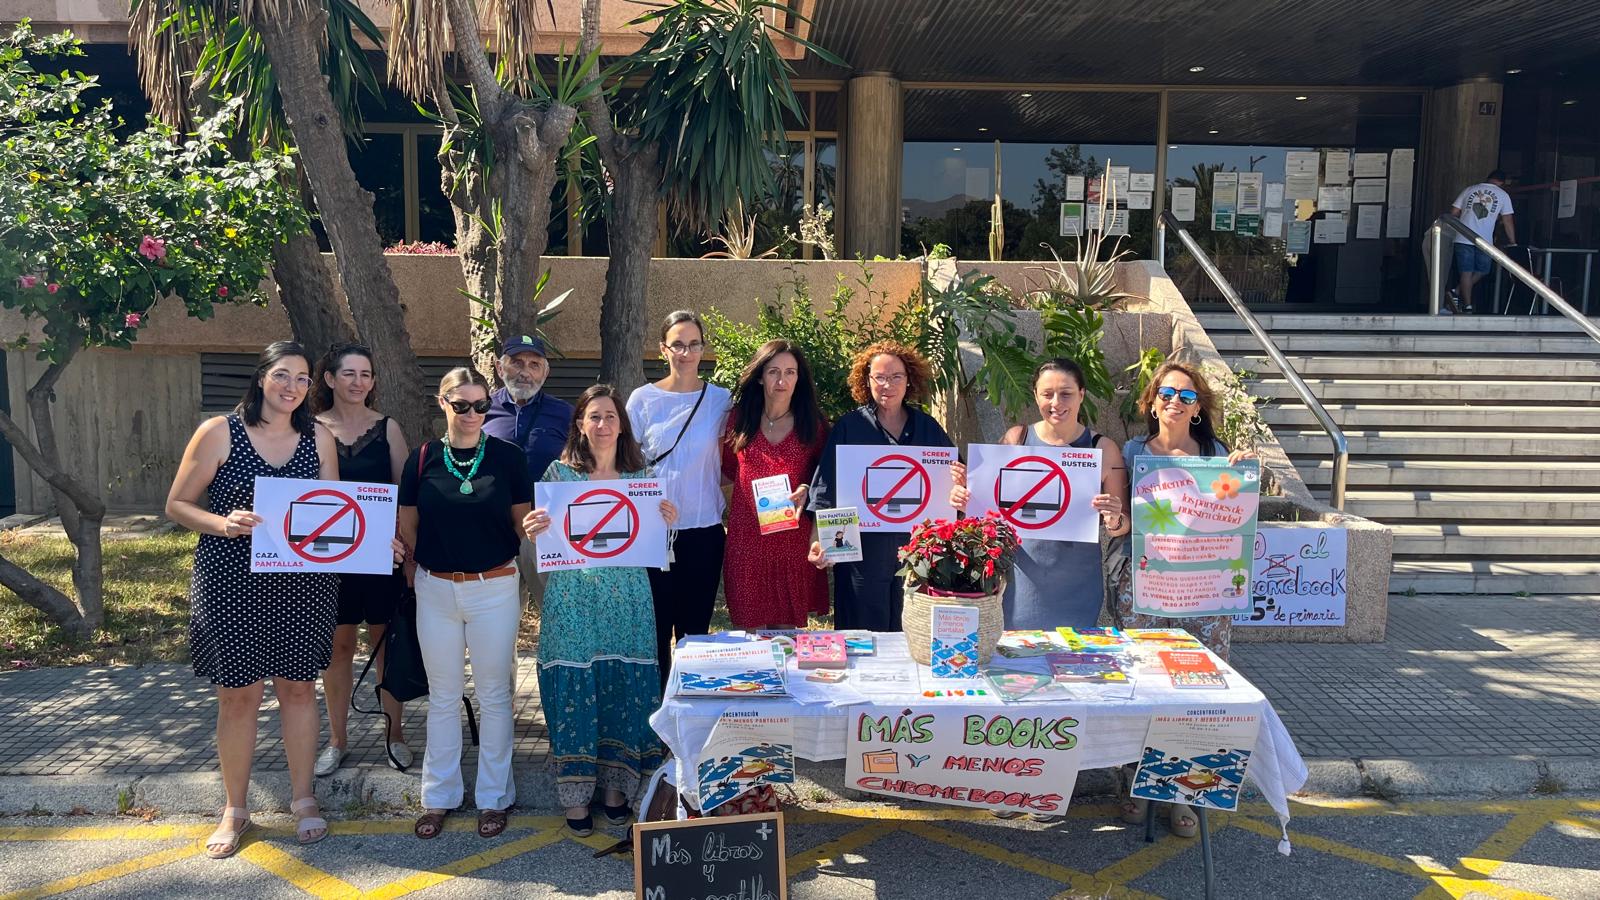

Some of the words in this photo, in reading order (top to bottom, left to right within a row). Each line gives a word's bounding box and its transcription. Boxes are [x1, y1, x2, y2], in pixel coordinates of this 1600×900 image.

[1480, 103, 1496, 114] 47
[1136, 478, 1194, 495] Disfrutemos
[1182, 493, 1194, 503] los
[1195, 498, 1231, 513] parques
[1232, 504, 1244, 514] de
[1178, 506, 1211, 519] nuestra
[1212, 512, 1242, 525] ciudad
[1300, 532, 1330, 560] al
[541, 559, 586, 567] PANTALLAS
[1253, 565, 1346, 596] omebook
[1274, 607, 1285, 621] de
[1289, 609, 1340, 624] primaria
[858, 708, 935, 743] MÁS
[963, 714, 1079, 750] BOOKS
[905, 753, 930, 769] Y
[942, 755, 1045, 776] MENOS
[857, 776, 1063, 811] CHROMEBOOKS
[652, 833, 692, 866] Más
[702, 831, 764, 862] libros
